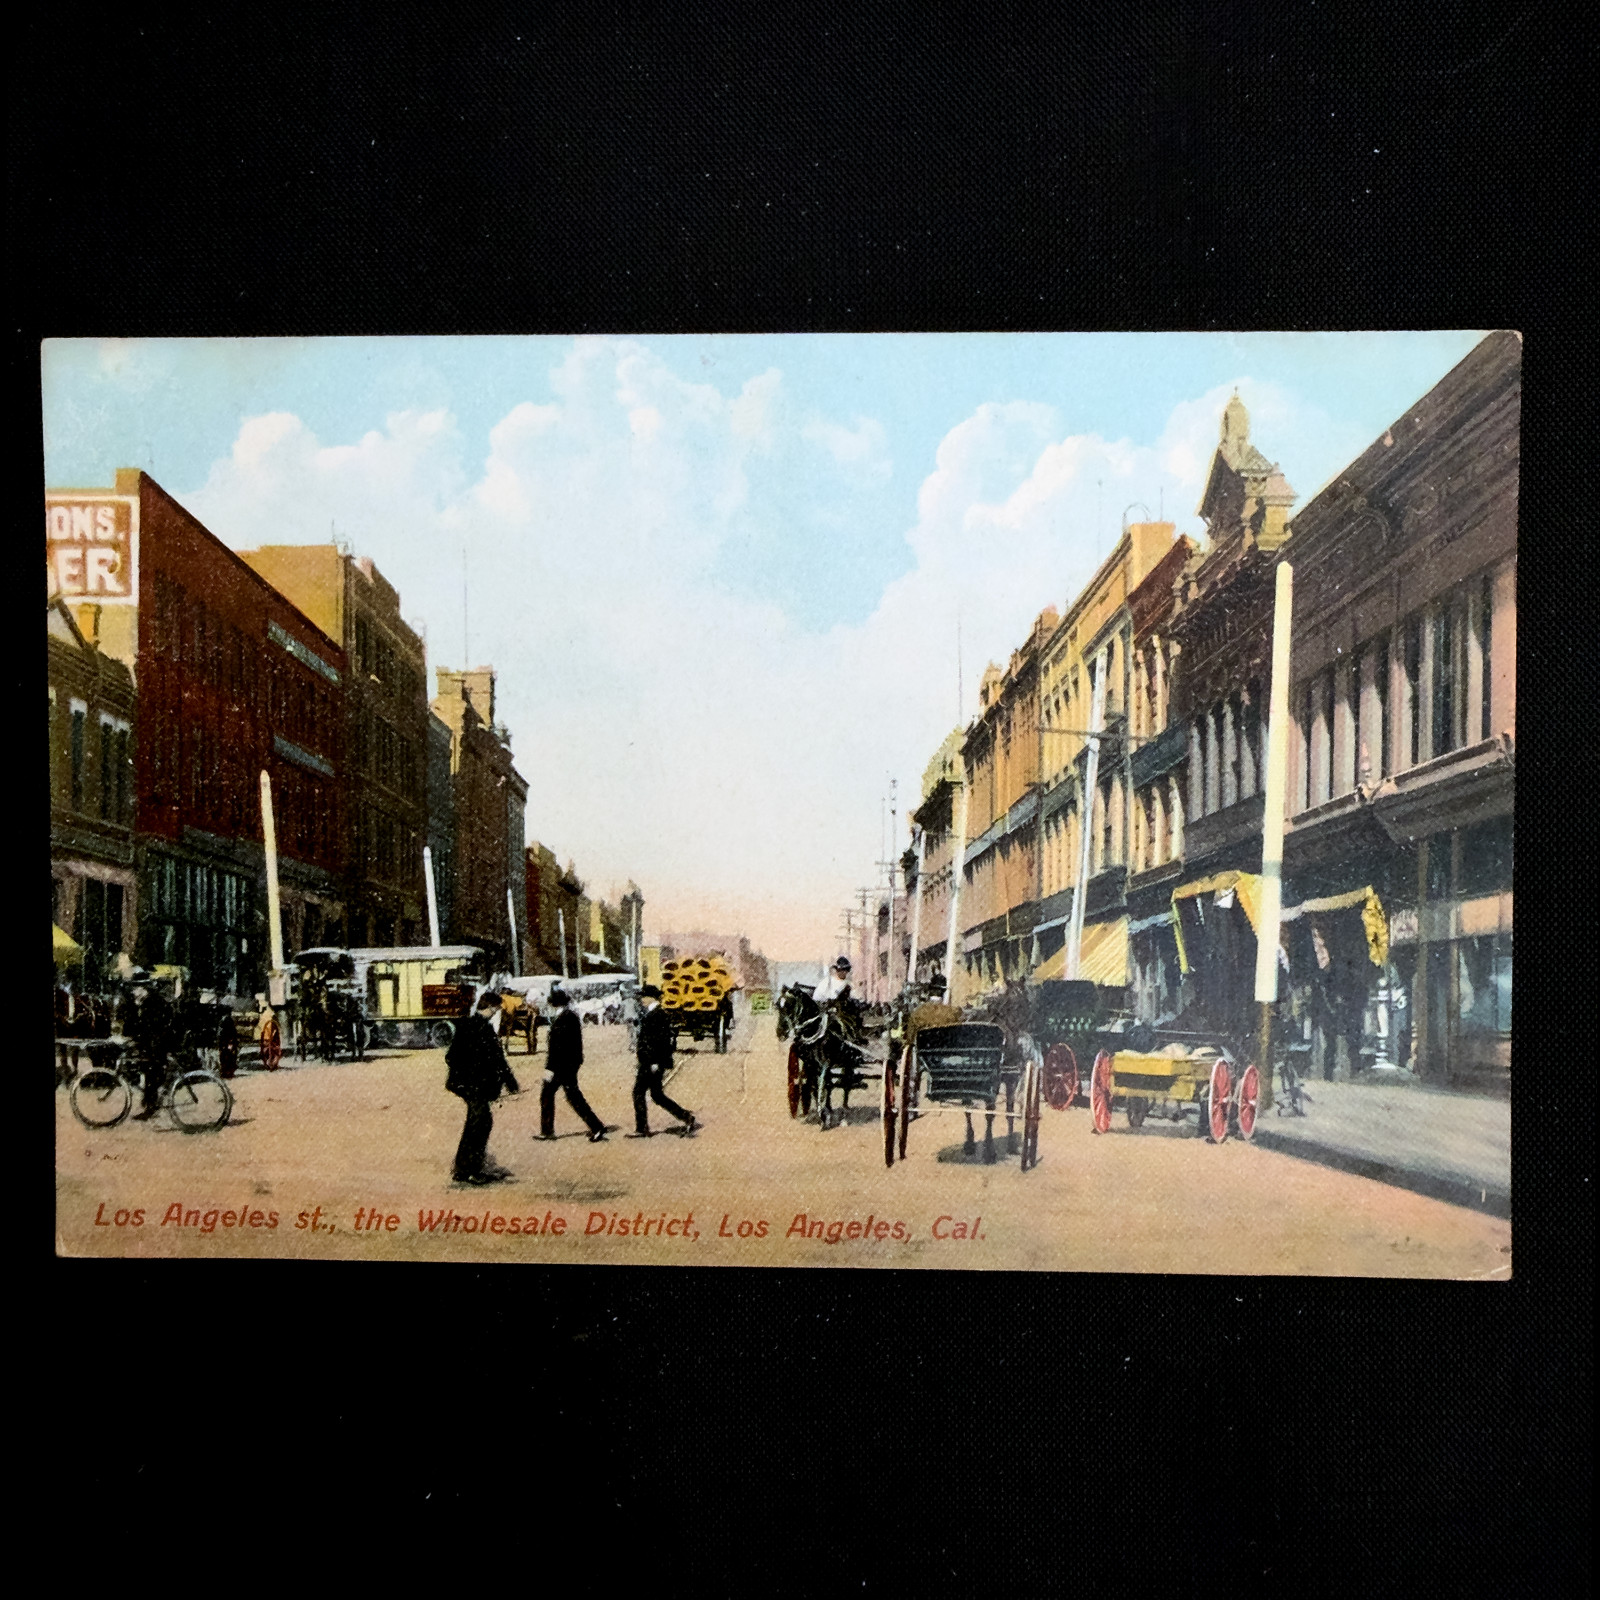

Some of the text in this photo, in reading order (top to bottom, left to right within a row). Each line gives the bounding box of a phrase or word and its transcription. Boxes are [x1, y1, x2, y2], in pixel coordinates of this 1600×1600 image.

[47, 506, 125, 541] ONS.
[49, 548, 124, 594] ER
[95, 1202, 987, 1244] Los Angeles st., the Wholesale District, Los Angeles, Cal.
